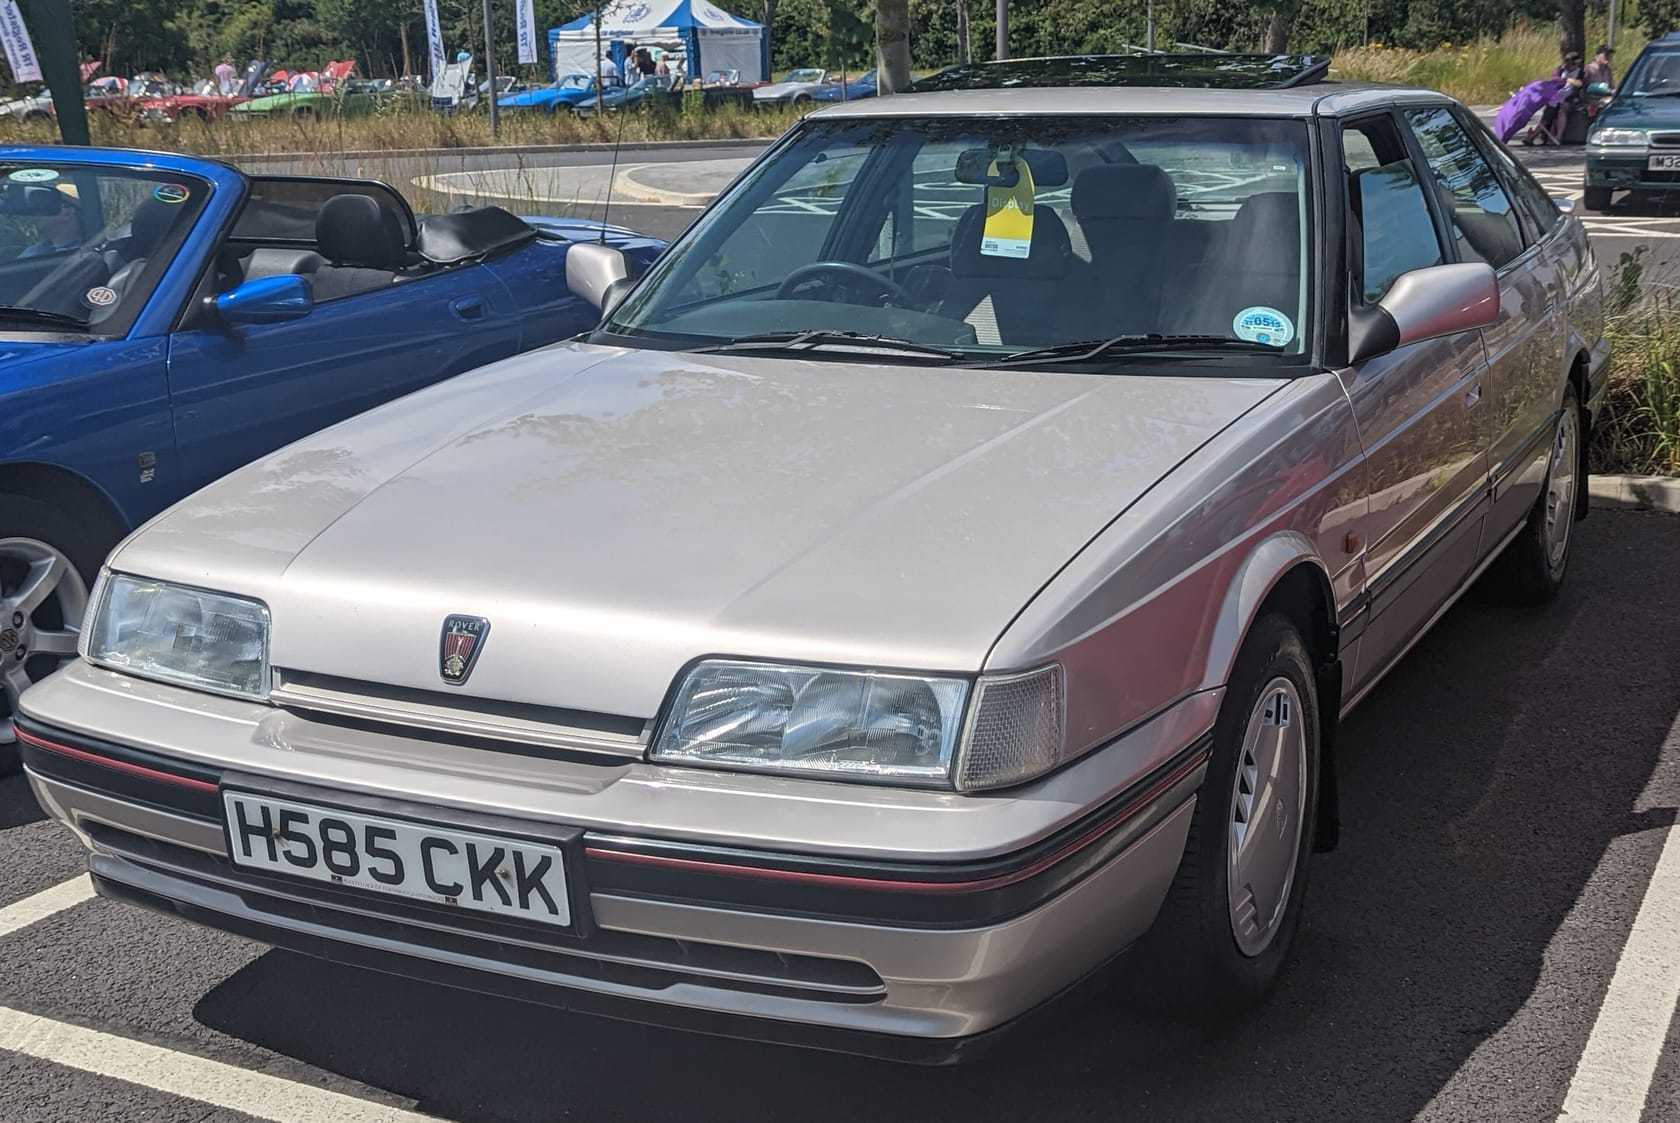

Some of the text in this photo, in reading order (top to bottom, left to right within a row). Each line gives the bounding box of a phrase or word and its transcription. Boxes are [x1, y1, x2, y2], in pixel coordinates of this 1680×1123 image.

[448, 620, 480, 631] ROVER
[234, 800, 560, 916] H585 CKK
